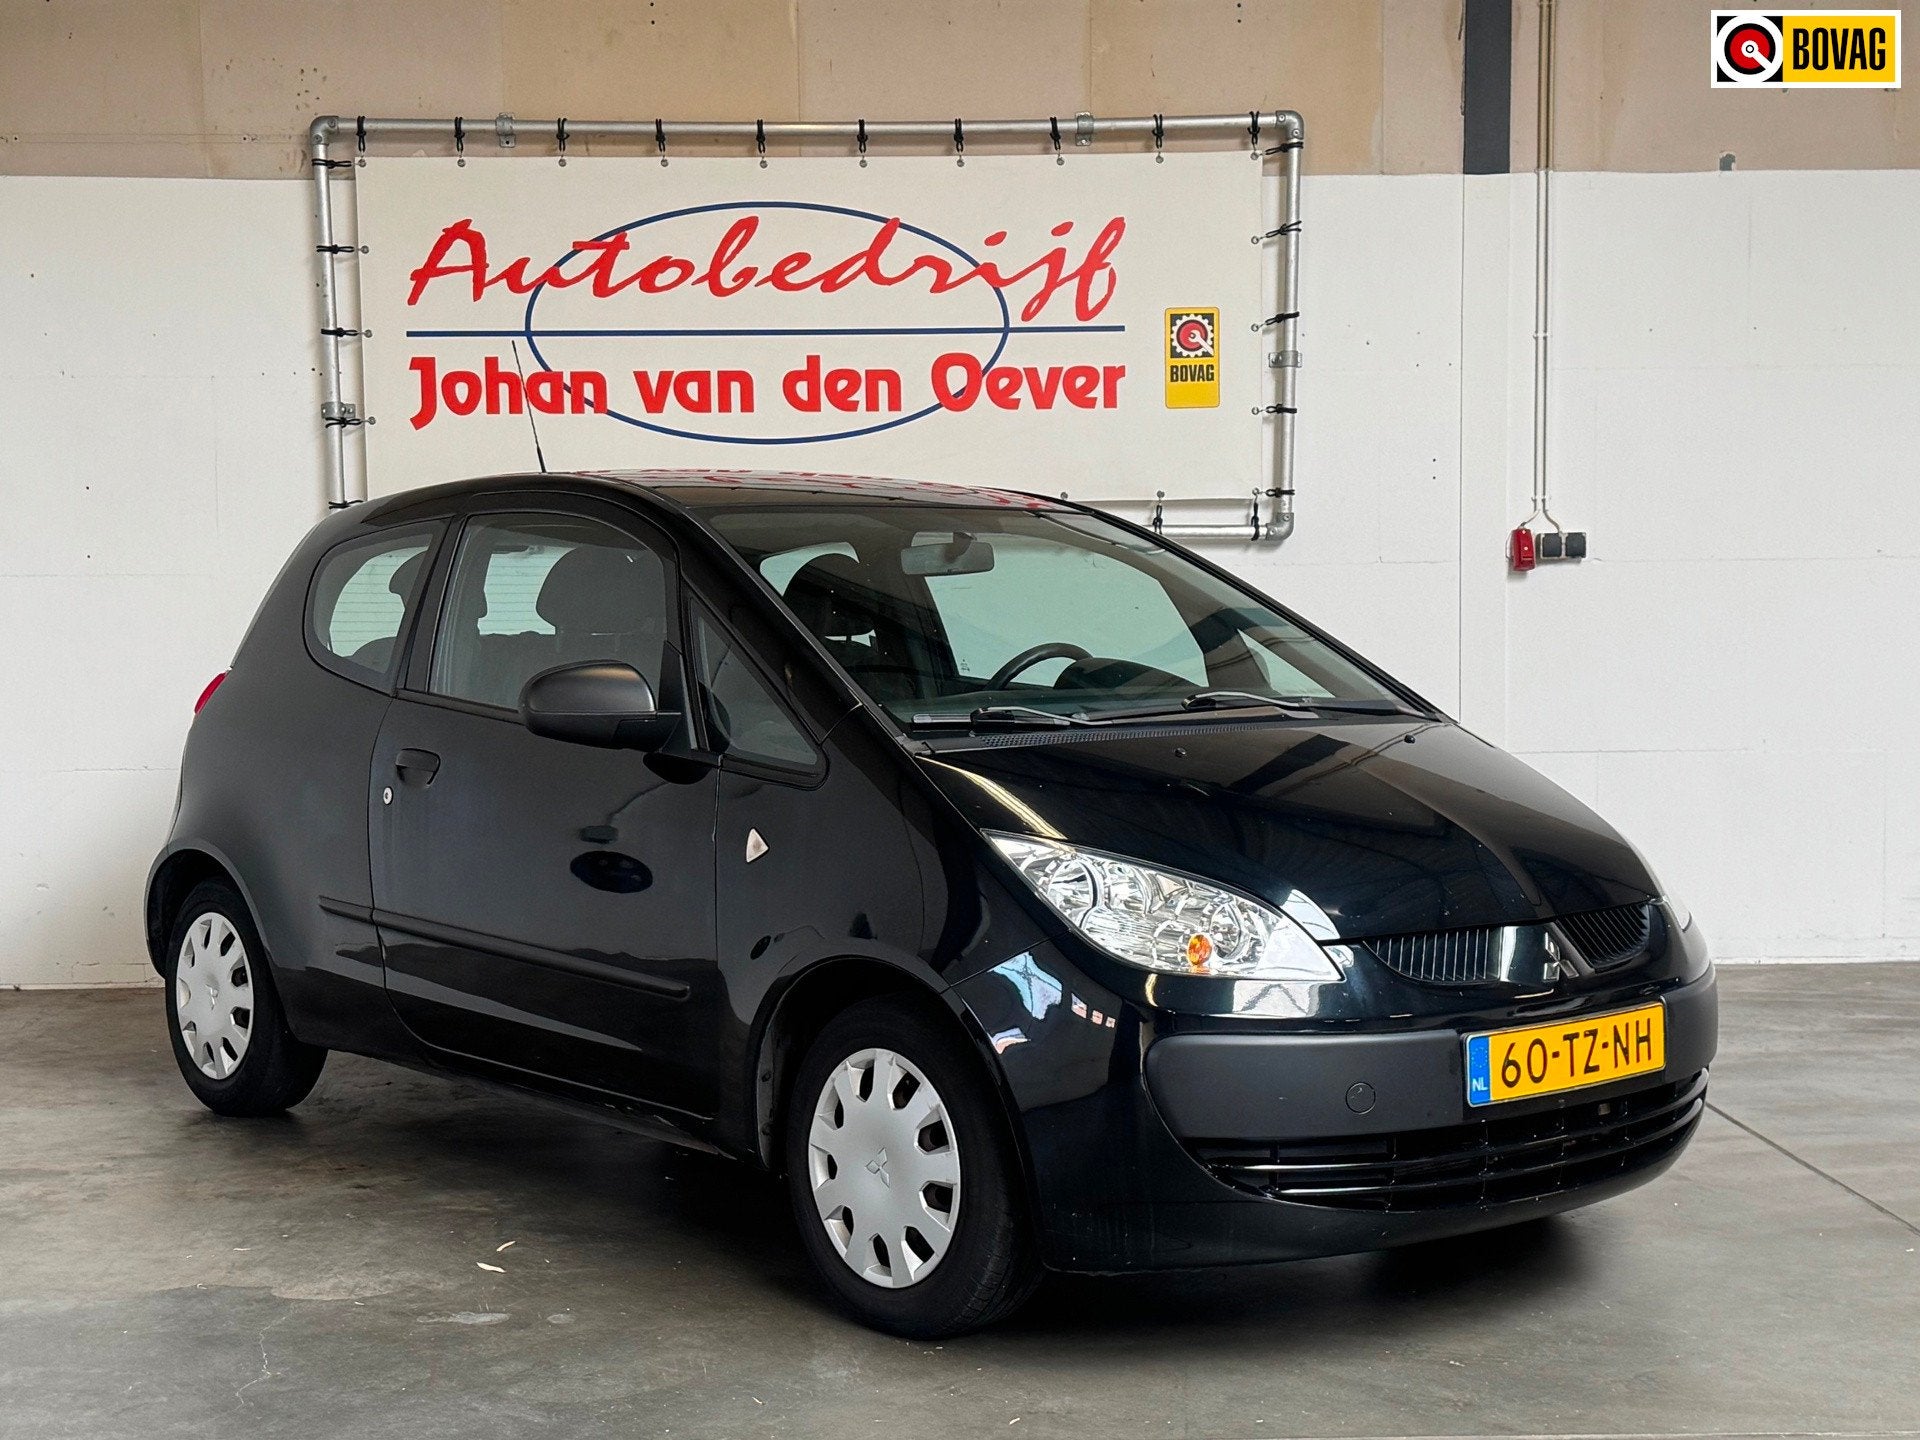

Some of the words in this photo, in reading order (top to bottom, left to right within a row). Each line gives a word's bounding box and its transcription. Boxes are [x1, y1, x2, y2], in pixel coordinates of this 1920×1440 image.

[407, 216, 1126, 322] Autobedrijf
[409, 356, 608, 430] Johan
[633, 370, 755, 415] van
[782, 355, 902, 413] den
[931, 352, 1127, 413] Oever
[1170, 364, 1215, 382] BOVAG
[1472, 1077, 1488, 1092] NL
[1501, 1017, 1652, 1089] 60-TZ-NH
